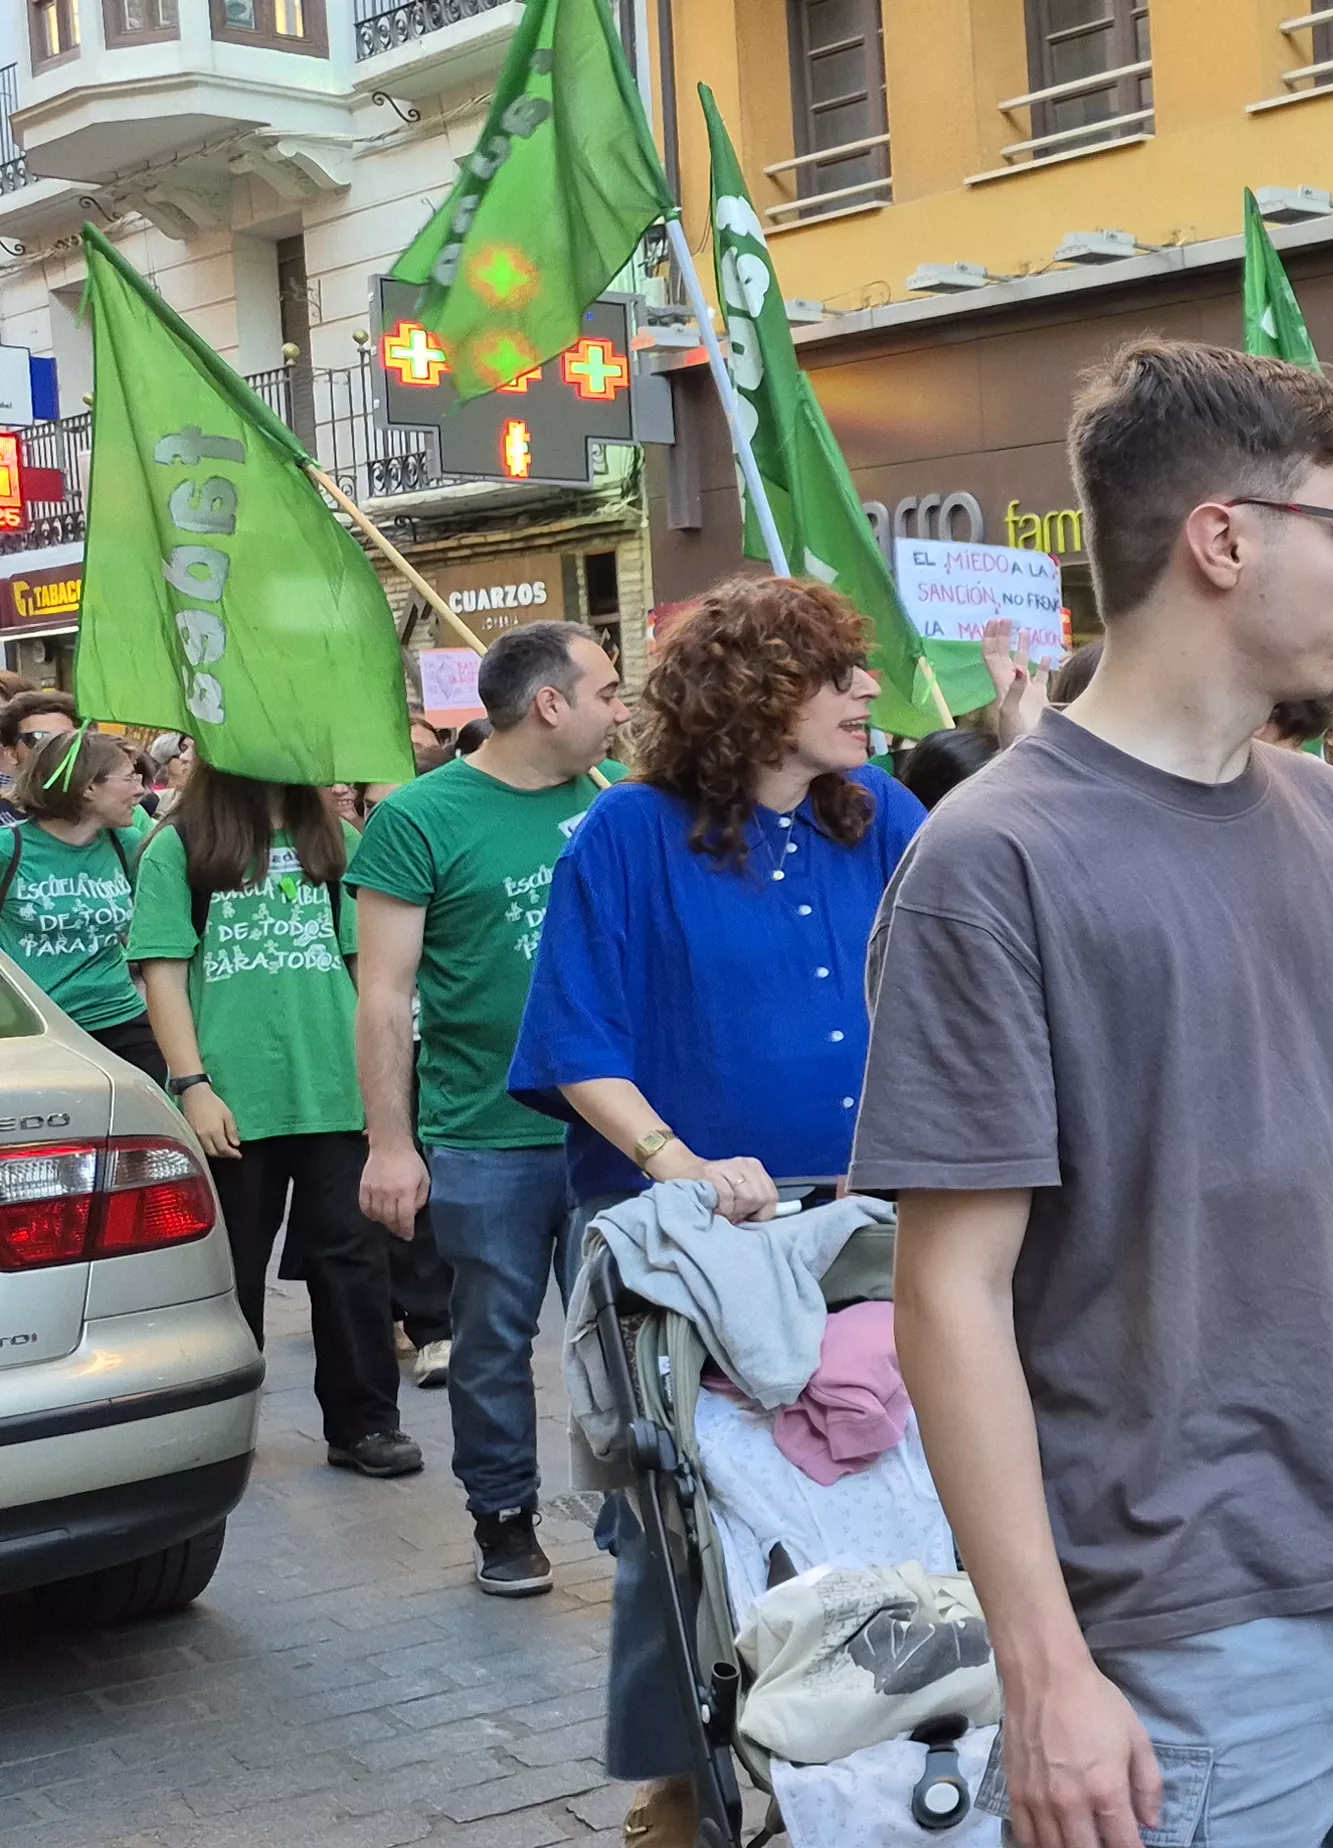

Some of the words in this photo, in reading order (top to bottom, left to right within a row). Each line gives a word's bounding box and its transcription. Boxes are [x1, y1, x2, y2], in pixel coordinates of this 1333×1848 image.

[914, 551, 936, 566] EL
[1012, 564, 1023, 575] A
[1029, 563, 1049, 577] LA
[450, 581, 547, 614] CUARZOS
[918, 580, 996, 605] SANCIÓN
[1003, 593, 1024, 606] NO
[925, 621, 945, 637] LA
[39, 913, 71, 932] DE
[218, 922, 249, 942] DE
[25, 937, 86, 958] PARA
[205, 951, 268, 978] PARA
